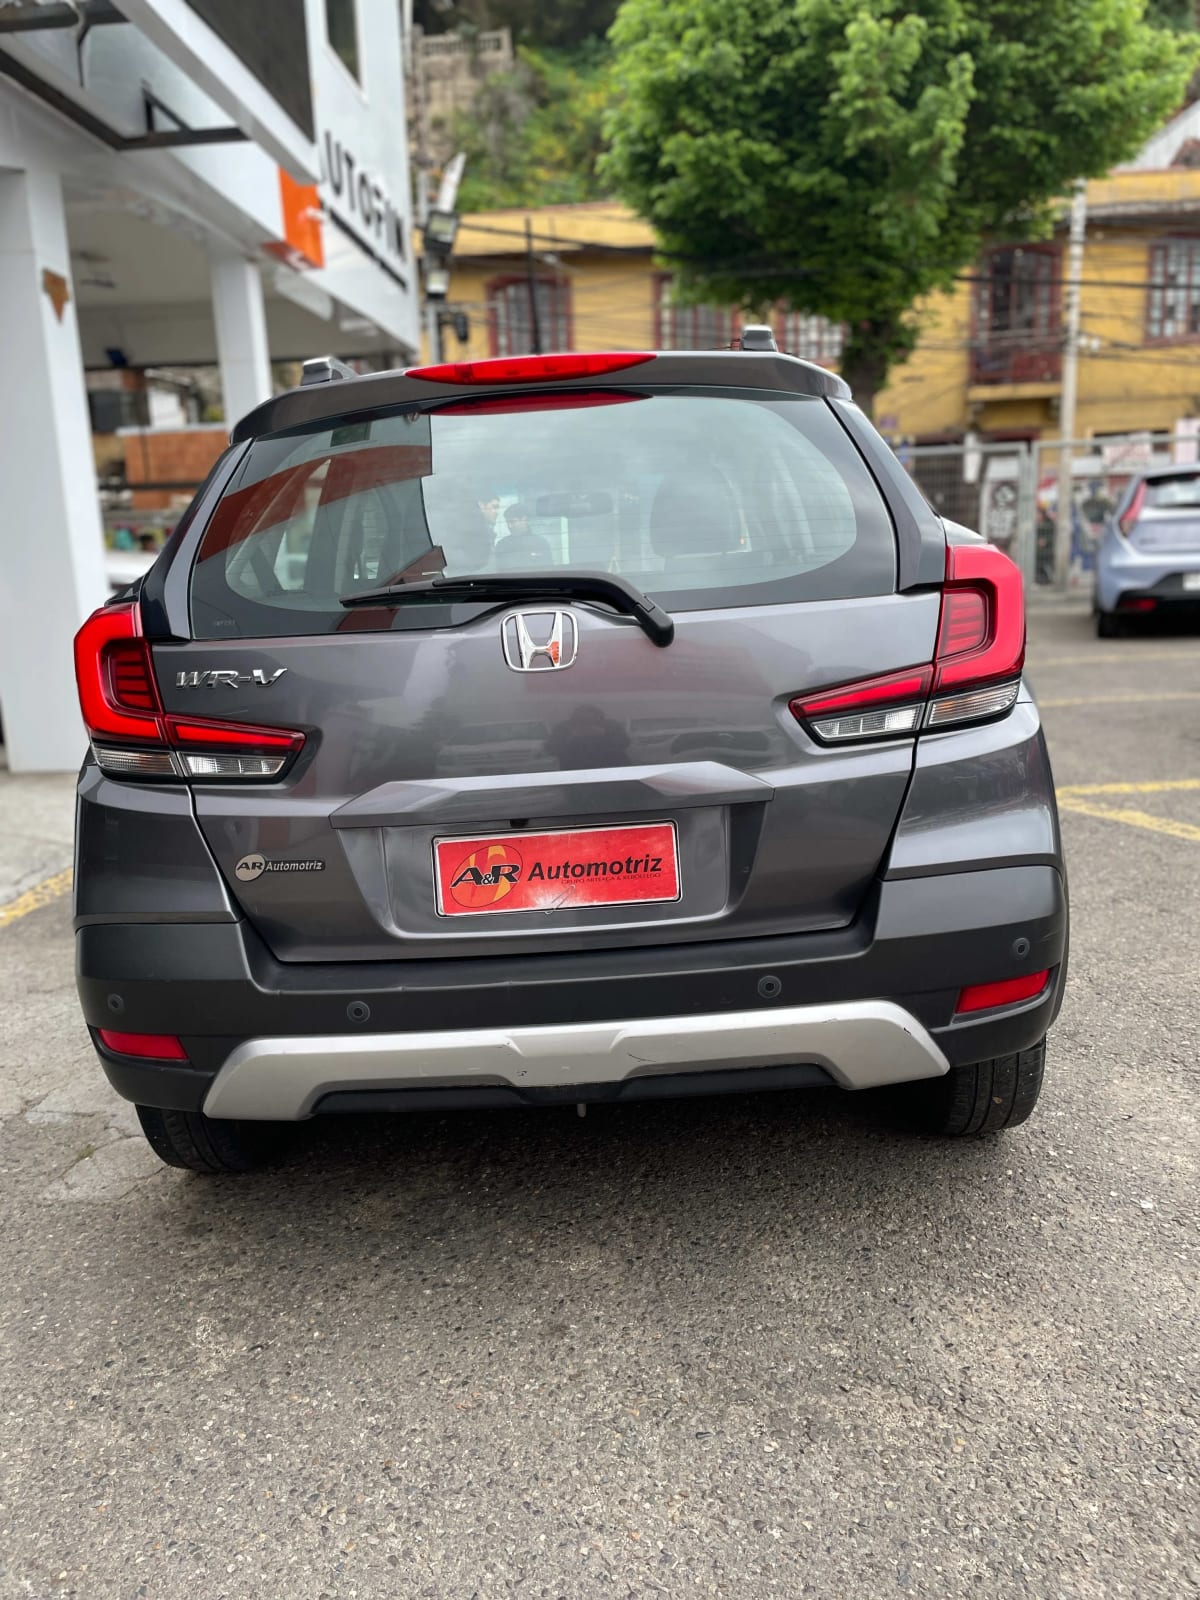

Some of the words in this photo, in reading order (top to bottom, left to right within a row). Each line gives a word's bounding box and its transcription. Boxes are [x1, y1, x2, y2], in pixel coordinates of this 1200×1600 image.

[320, 130, 407, 263] UTOFIN
[176, 667, 288, 688] WR-V
[265, 860, 322, 871] Automotriz
[527, 854, 662, 881] Automotriz
